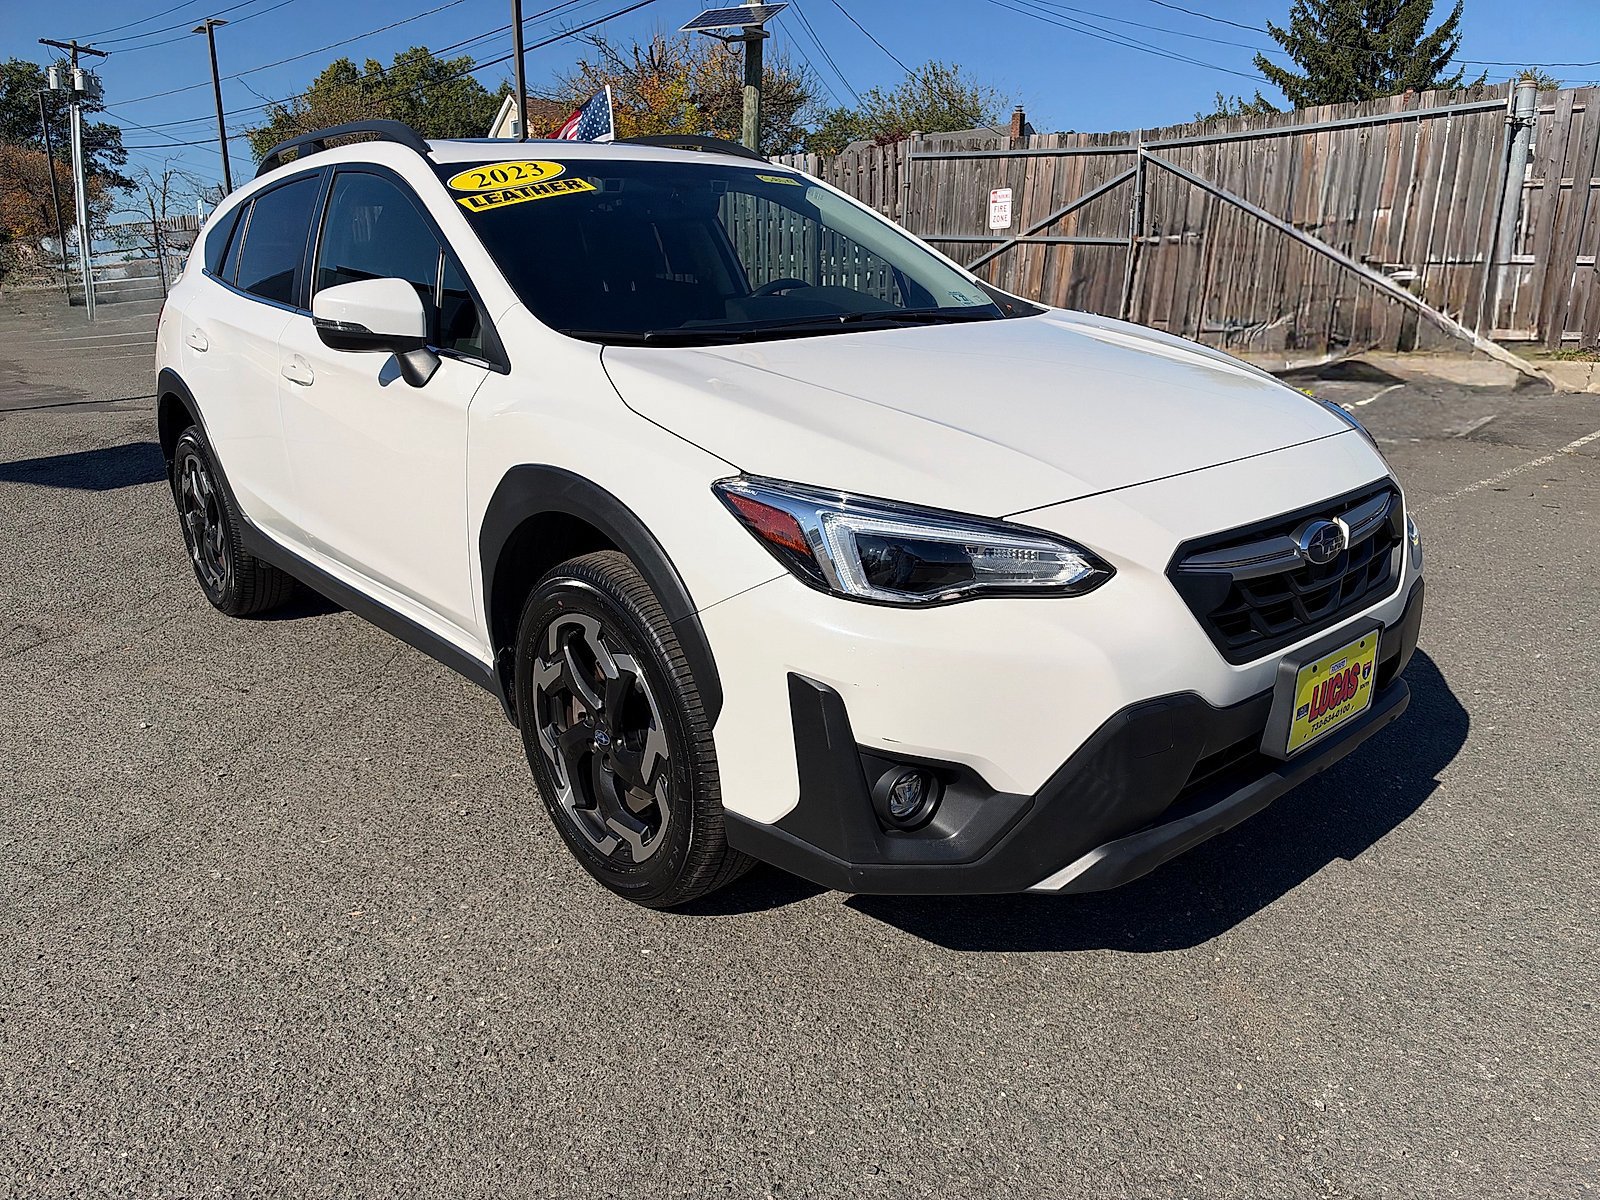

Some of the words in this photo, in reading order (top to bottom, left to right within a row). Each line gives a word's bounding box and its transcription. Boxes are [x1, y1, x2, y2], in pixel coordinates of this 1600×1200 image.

[470, 163, 544, 188] 2023
[468, 179, 584, 208] LEATHER
[992, 214, 1008, 223] ZONE
[993, 204, 1007, 213] FIRE
[1308, 662, 1360, 723] LUCAS
